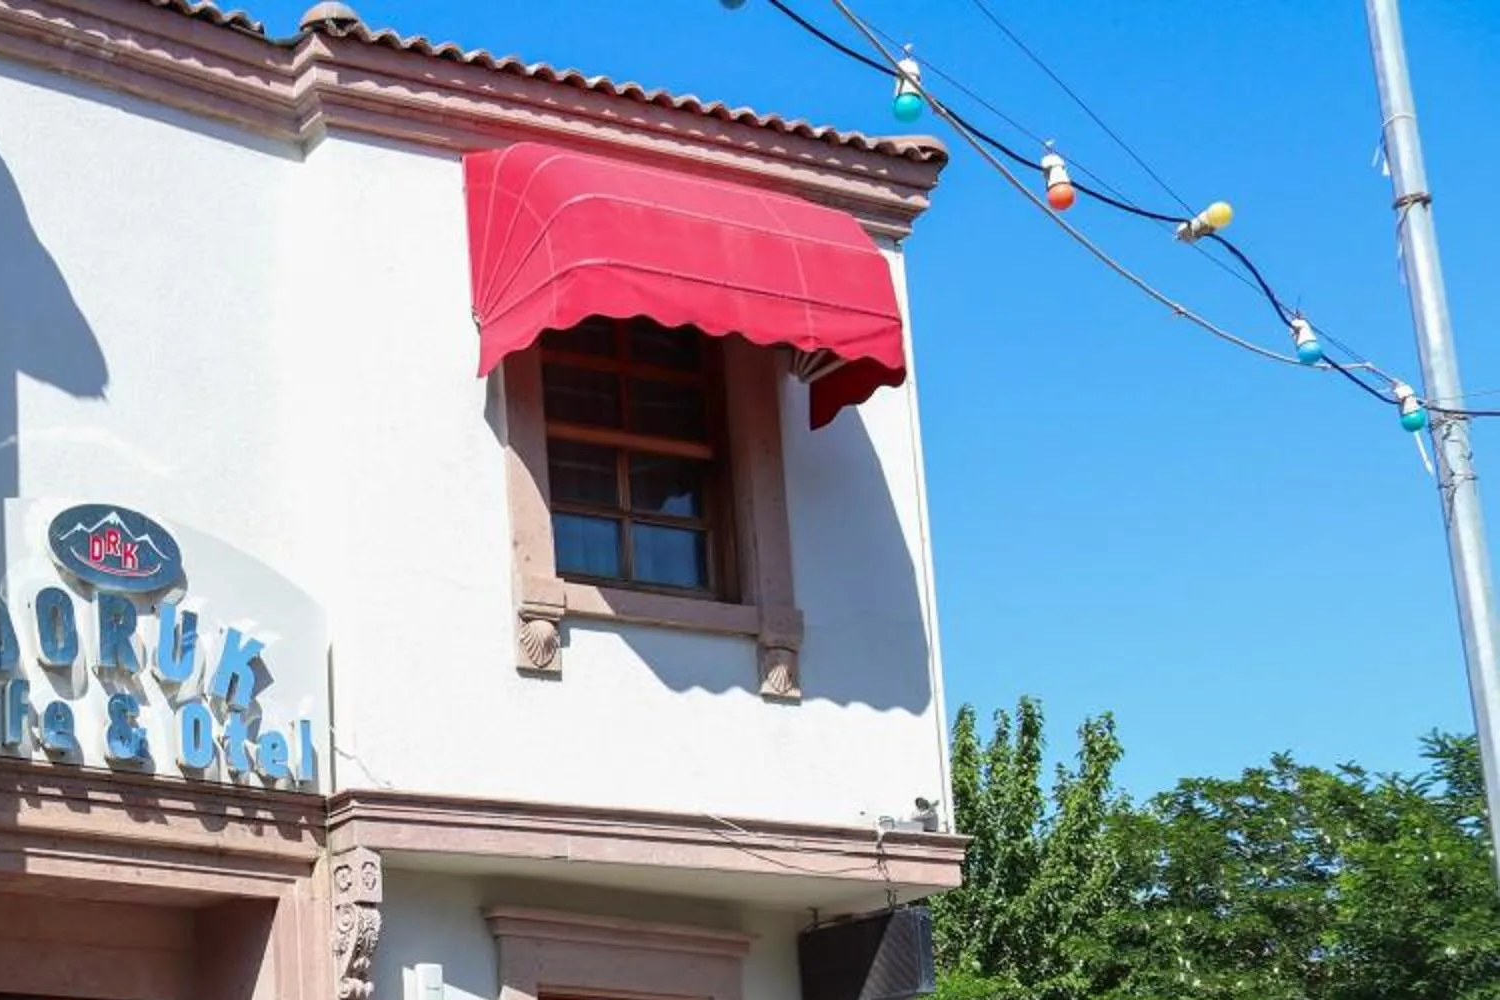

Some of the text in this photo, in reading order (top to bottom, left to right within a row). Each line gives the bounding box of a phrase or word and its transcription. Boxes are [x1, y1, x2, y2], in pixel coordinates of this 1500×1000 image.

[88, 527, 138, 570] DRK
[107, 692, 148, 759] &
[180, 701, 314, 782] Otel
